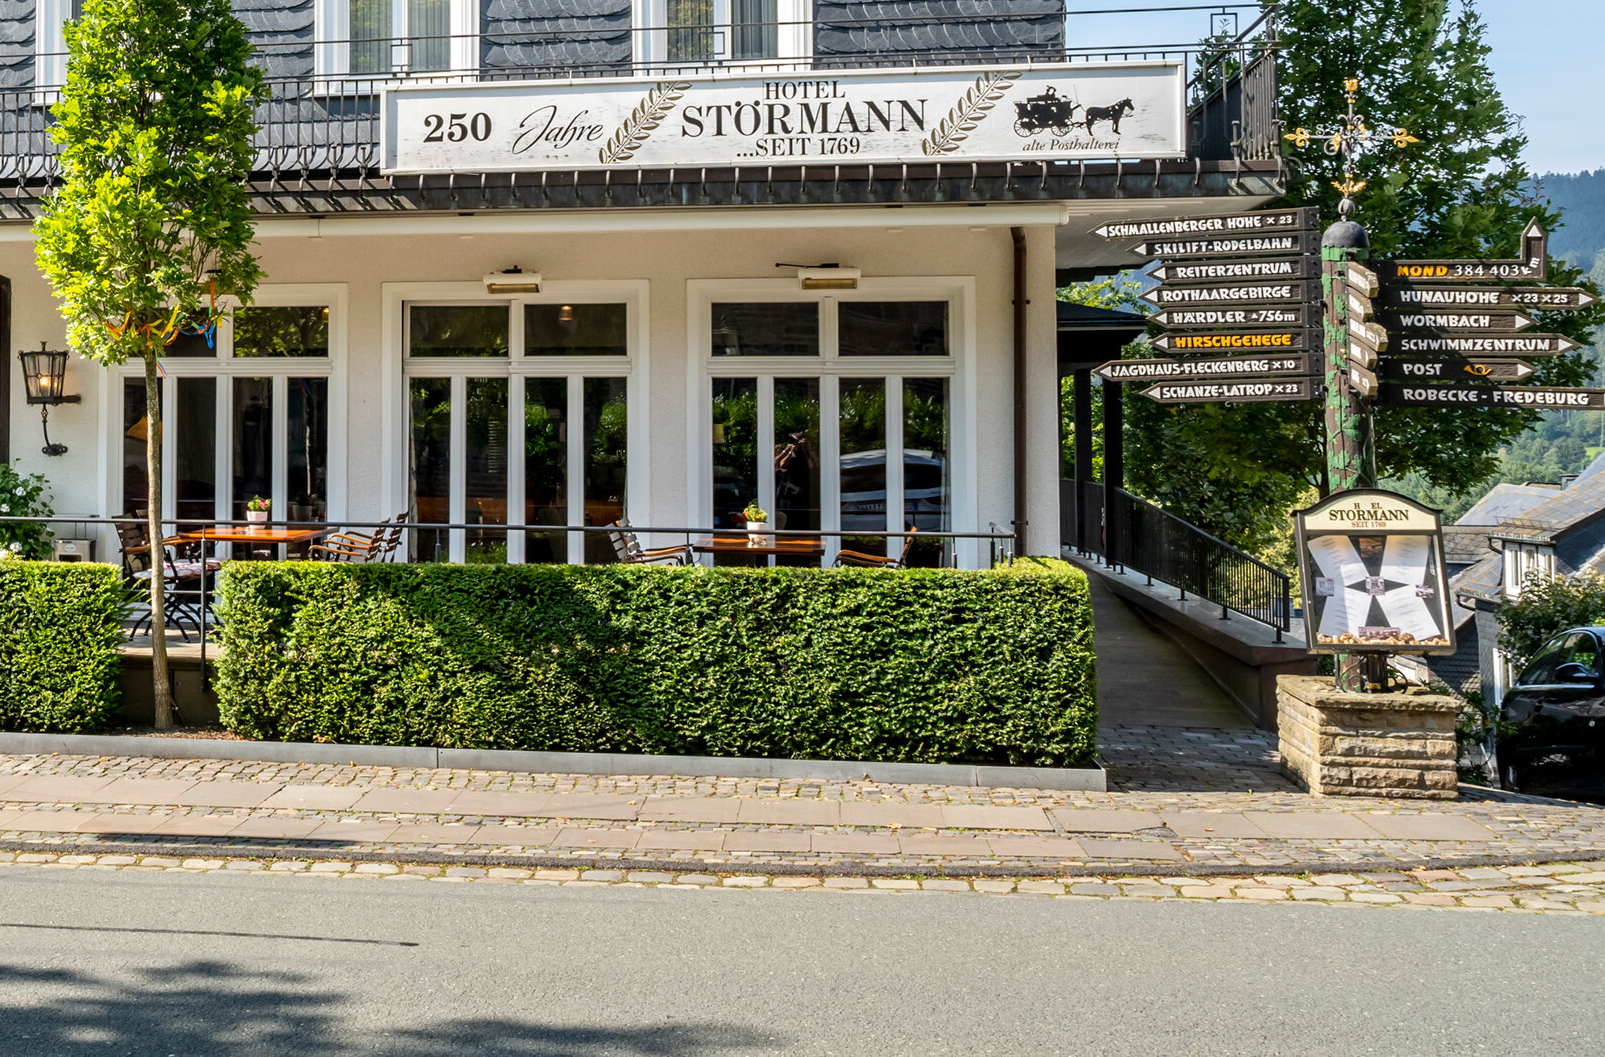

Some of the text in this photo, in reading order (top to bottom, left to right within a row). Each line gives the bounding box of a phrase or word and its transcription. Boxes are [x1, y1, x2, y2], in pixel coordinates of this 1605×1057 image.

[765, 80, 846, 100] HOTEL
[681, 99, 928, 137] STÖRMANN
[423, 105, 603, 154] 250 Jahre
[819, 136, 860, 155] 1769
[1022, 138, 1120, 151] alte Posthalterei
[1108, 218, 1223, 237] SCHMALLENBERGER
[1227, 215, 1262, 229] HÖHE
[1279, 215, 1293, 224] 23
[1154, 237, 1292, 255] SKILIFT-RODELBAHN
[1176, 262, 1292, 279] REITERZENTRUM
[1397, 265, 1448, 277] MOND
[1453, 264, 1484, 277] 384
[1489, 264, 1519, 276] 403
[1162, 286, 1291, 302] ROTHAARGEBIRGE
[1400, 290, 1500, 304] HUNAUHÖHE
[1523, 294, 1538, 303] 23
[1553, 294, 1568, 303] 25
[1173, 310, 1295, 324] HÄRDLER 756m
[1400, 315, 1490, 328] WORMBACH
[1175, 334, 1292, 348] HIRSCHGEHEGE
[1401, 339, 1550, 351] SCHWIMMZENTRUM
[1112, 360, 1269, 377] JAGDHAUS-FLECKENBERG
[1283, 360, 1295, 369] 10
[1402, 363, 1443, 376] POST
[1162, 383, 1273, 399] SCHANZE-LATROP
[1286, 384, 1298, 393] 23
[1402, 388, 1478, 402] ROBECKE
[1492, 390, 1590, 406] FREDEBURG
